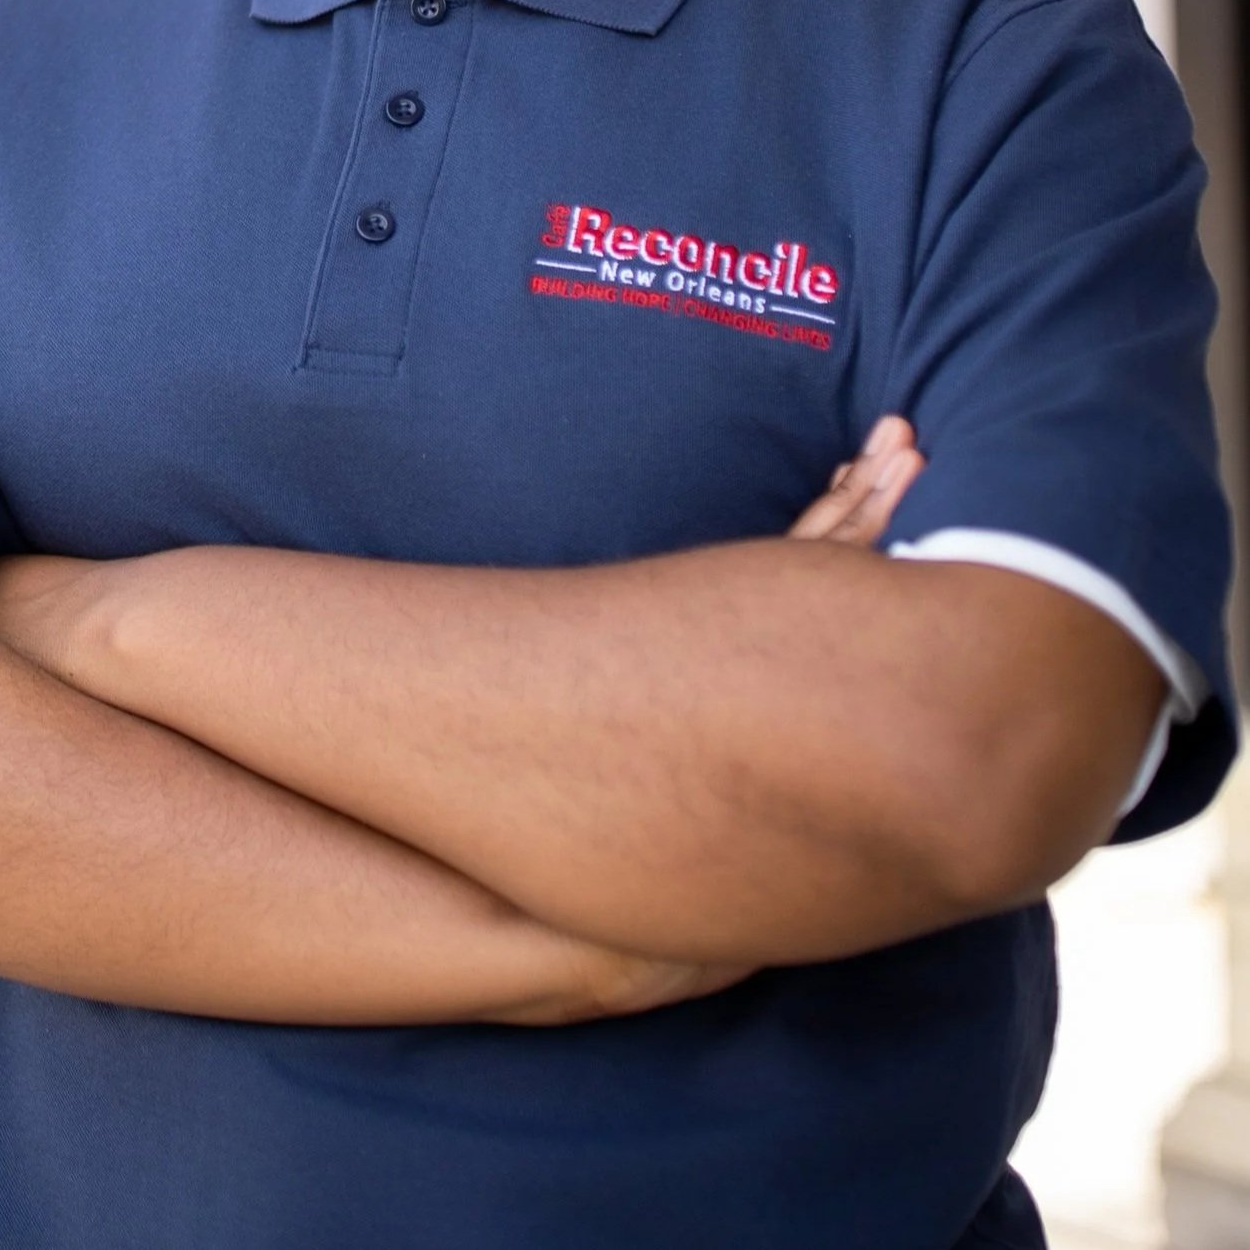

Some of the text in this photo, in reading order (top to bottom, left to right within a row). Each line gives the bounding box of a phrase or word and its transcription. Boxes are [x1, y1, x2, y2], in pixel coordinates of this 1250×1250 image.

[567, 206, 839, 304] Reconcile
[600, 260, 767, 315] New Orleans
[530, 276, 831, 351] BUILDING HOPE CHANGING LIVES
